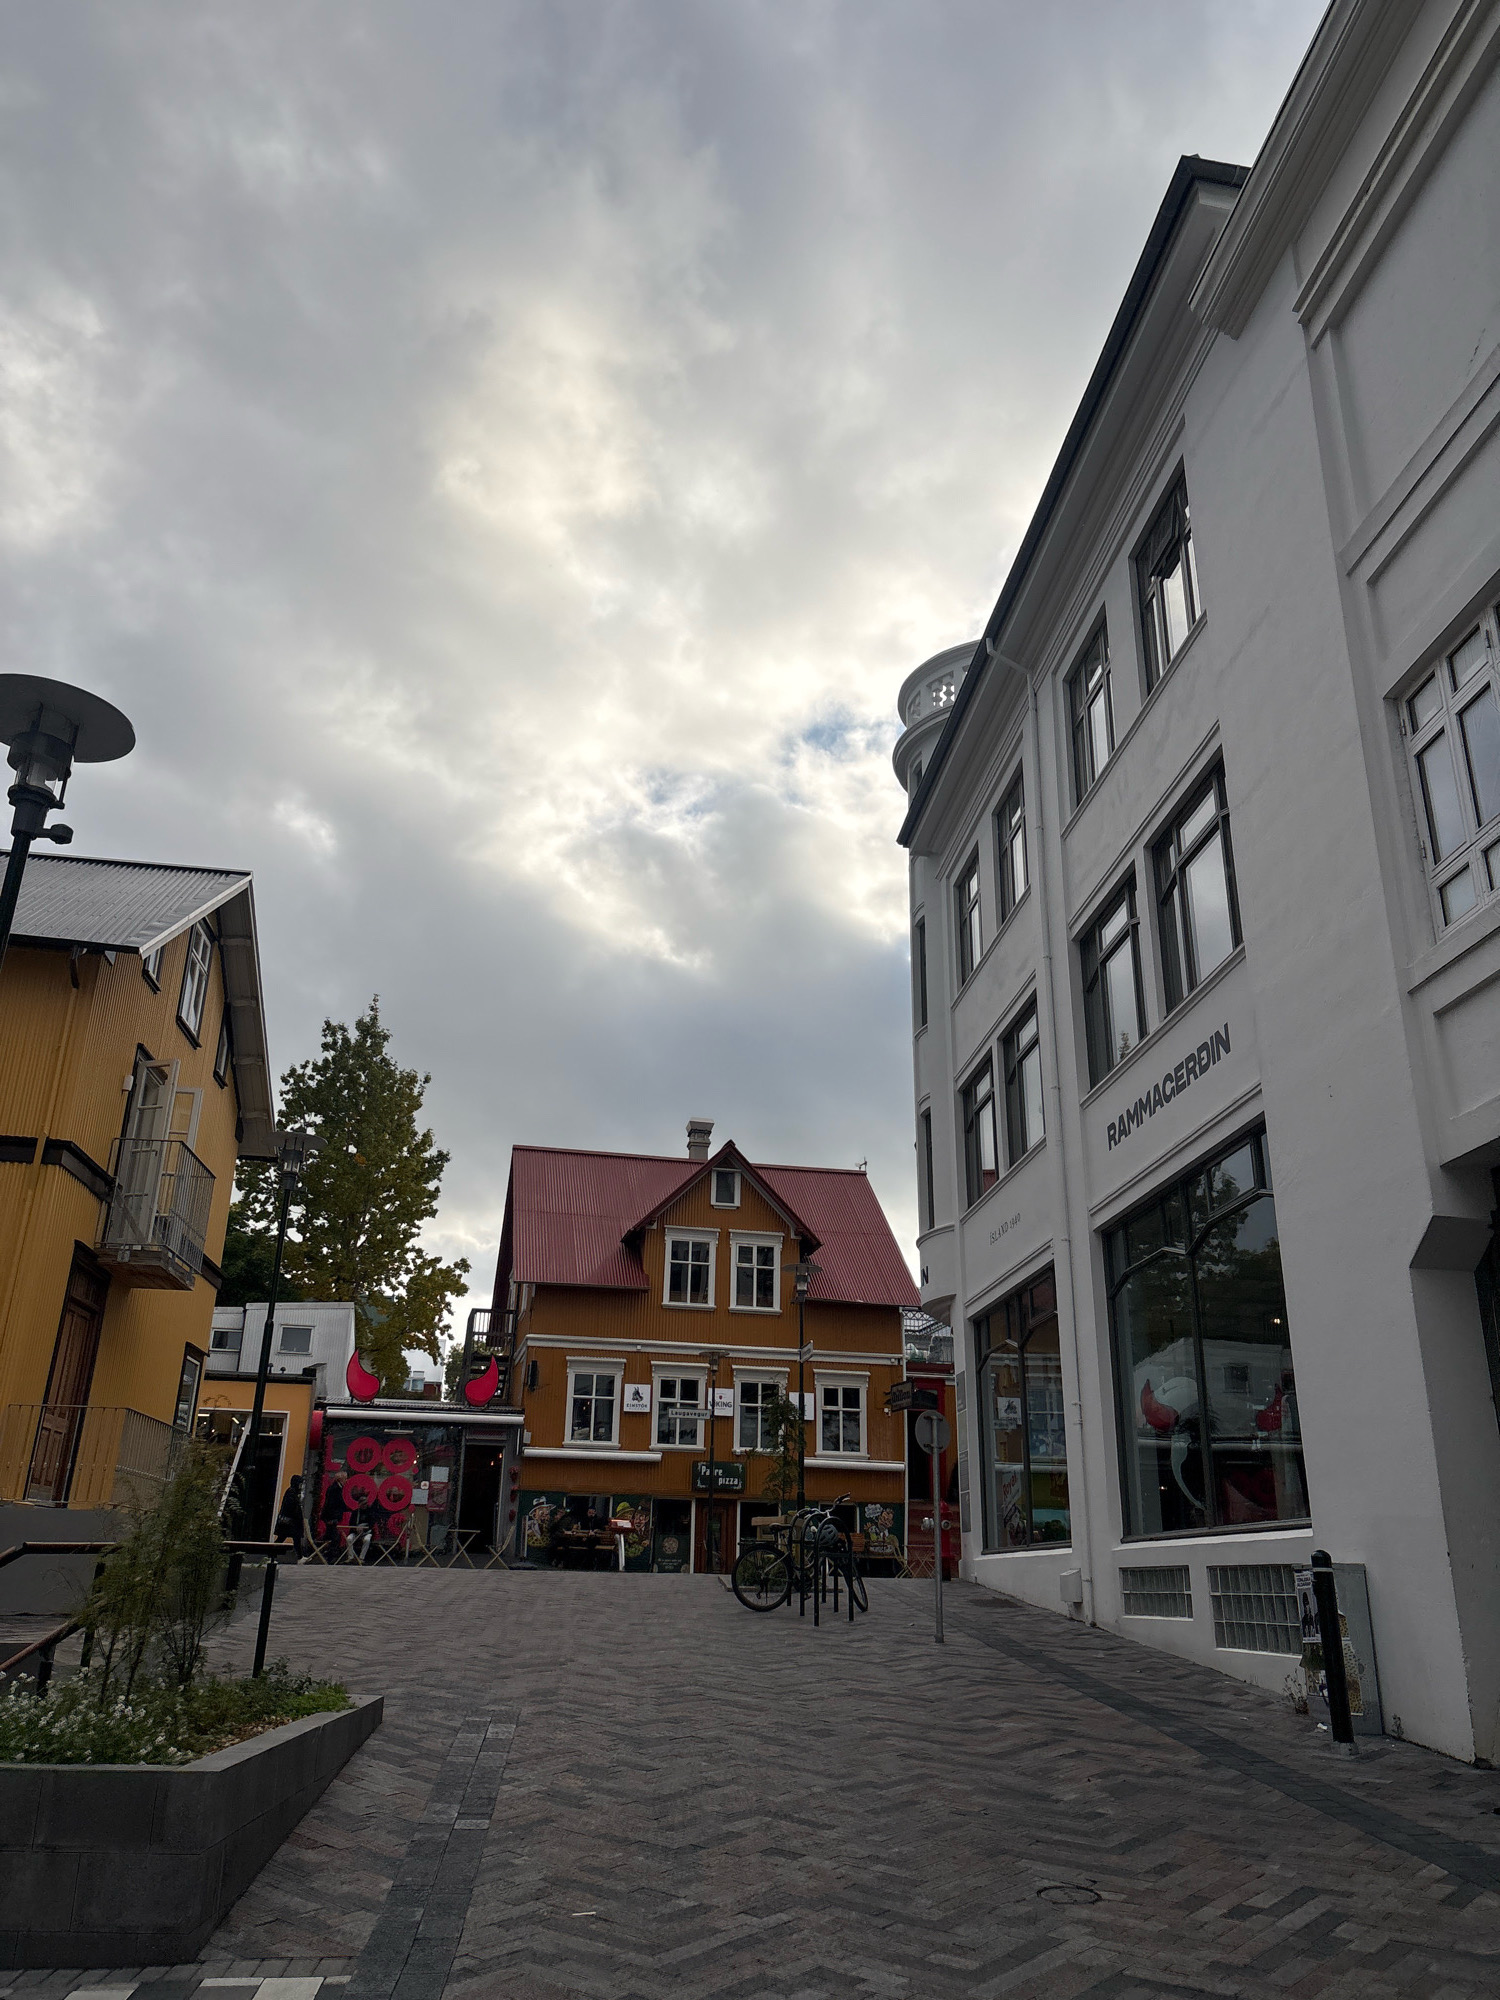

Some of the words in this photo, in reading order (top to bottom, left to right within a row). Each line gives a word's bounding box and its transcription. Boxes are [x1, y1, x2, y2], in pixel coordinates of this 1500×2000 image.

[1107, 1022, 1231, 1151] RAMMAGERÐIN
[701, 1465, 723, 1476] Pare
[718, 1477, 738, 1486] pizza
